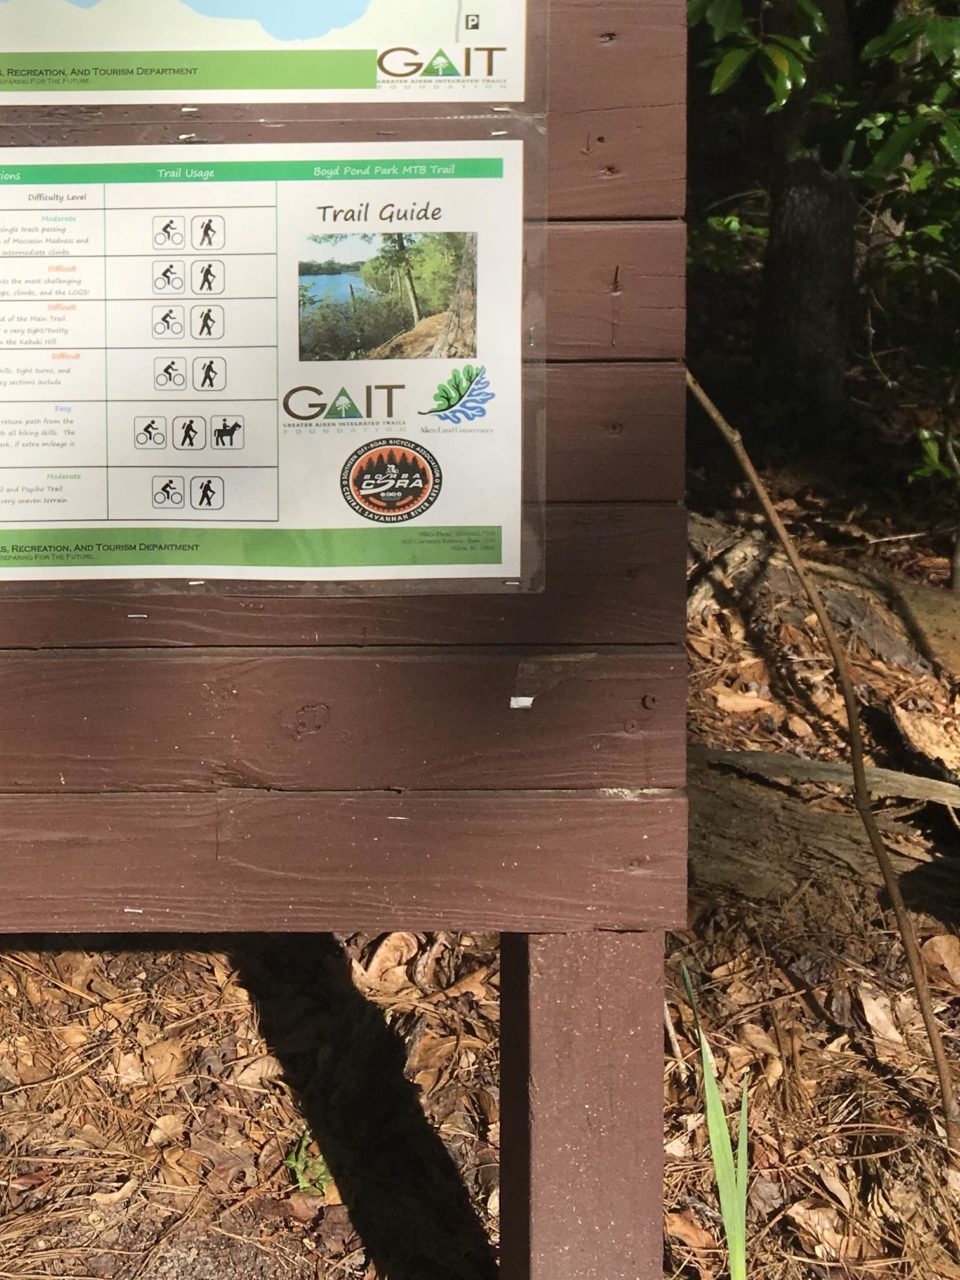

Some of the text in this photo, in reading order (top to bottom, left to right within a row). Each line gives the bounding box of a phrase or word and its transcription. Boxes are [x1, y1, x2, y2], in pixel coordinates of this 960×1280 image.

[377, 47, 507, 77] GAIT
[7, 69, 68, 77] RECREATION,
[70, 68, 90, 76] AND
[93, 68, 134, 76] TOURISM
[137, 67, 198, 76] DEPARTMENT
[158, 168, 214, 179] Trail Usage
[313, 165, 455, 178] Boyd Pond Park MTB Trail
[28, 193, 87, 203] Difficulty Level
[316, 201, 442, 222] Trail Guide
[283, 385, 406, 420] GAIT
[11, 545, 72, 553] RECREATION,
[74, 544, 94, 552] AND
[96, 543, 136, 551] TOURISM
[139, 543, 200, 551] DEPARTMENT
